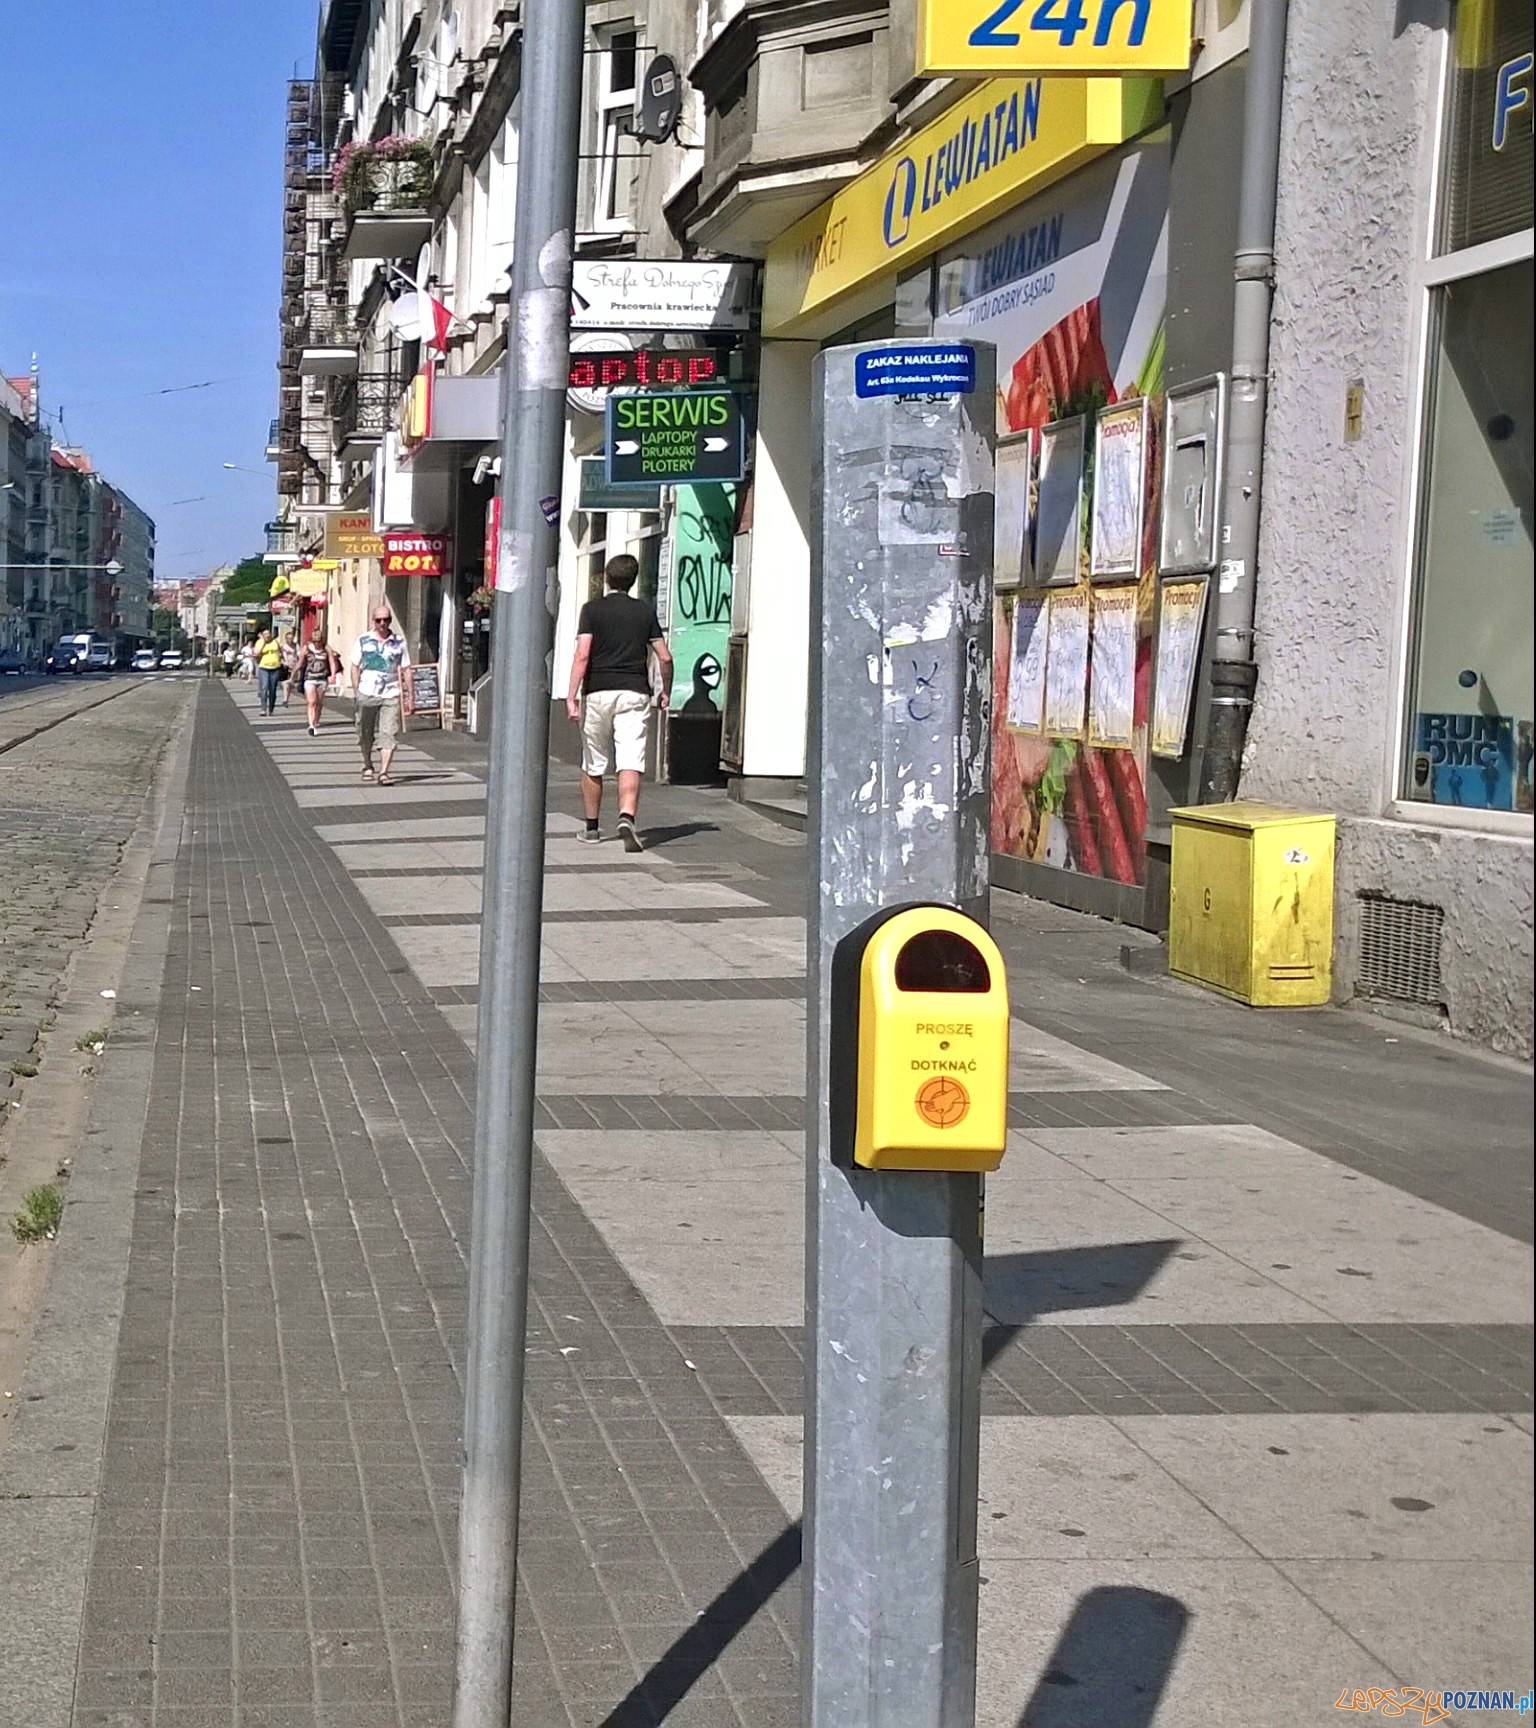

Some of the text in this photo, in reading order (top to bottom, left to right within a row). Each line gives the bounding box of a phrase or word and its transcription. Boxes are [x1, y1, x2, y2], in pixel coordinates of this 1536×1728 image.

[921, 78, 1041, 213] LEWIATAN
[586, 264, 638, 297] Strefa
[644, 267, 702, 300] Dobrego
[991, 289, 1022, 318] DOBRY
[1022, 272, 1056, 306] SĄSIAD
[611, 303, 719, 312] Pracownia krawiecka
[866, 356, 903, 369] ZAKAZ
[895, 375, 930, 383] Kodeksu
[617, 396, 729, 428] SERWIS
[641, 430, 698, 445] LAPTOPY
[641, 445, 696, 458] DRUKARKI
[642, 459, 696, 473] PLOTERY
[388, 540, 443, 552] BISTRO
[1425, 715, 1498, 741] RUN
[1426, 741, 1500, 766] DMC
[1204, 888, 1211, 911] G
[916, 1023, 974, 1038] PROSZĘ
[911, 1058, 977, 1074] DOTKNĄĆ
